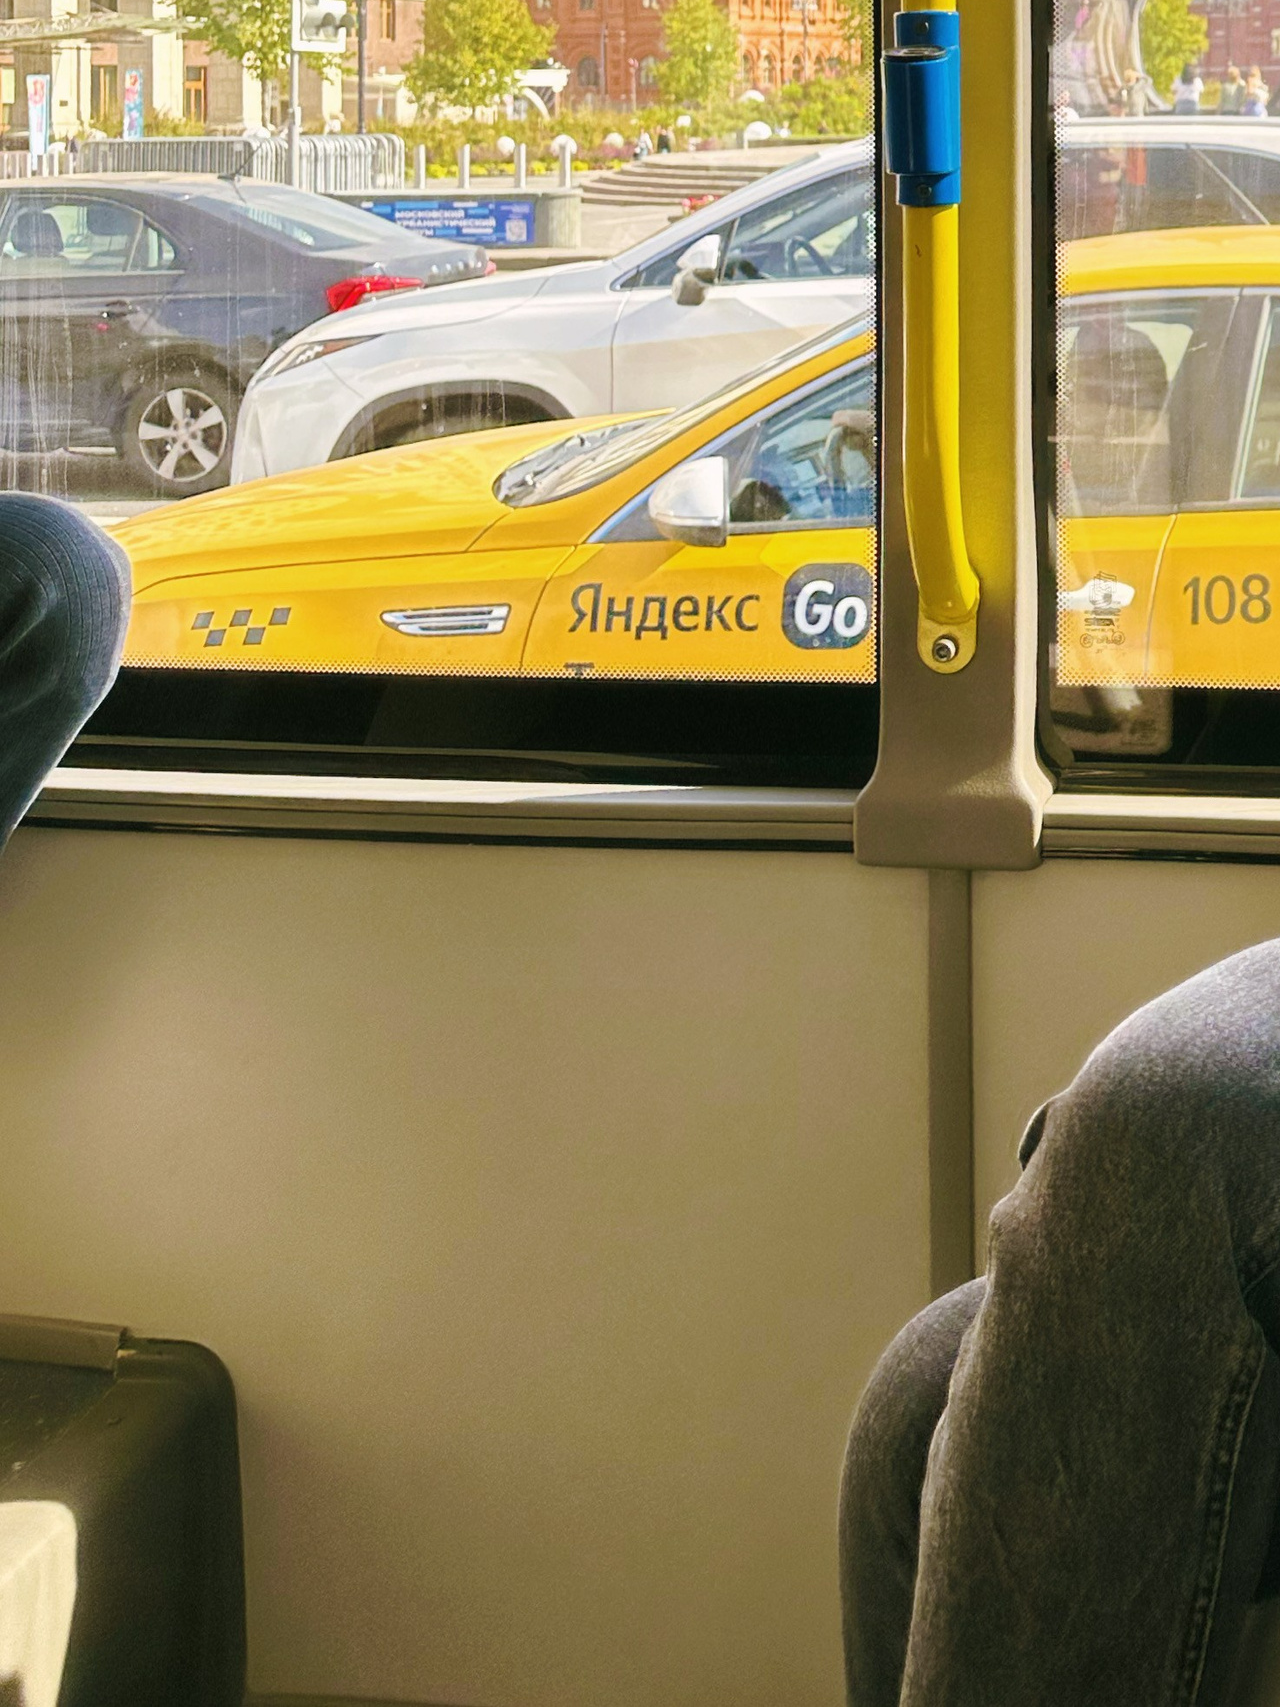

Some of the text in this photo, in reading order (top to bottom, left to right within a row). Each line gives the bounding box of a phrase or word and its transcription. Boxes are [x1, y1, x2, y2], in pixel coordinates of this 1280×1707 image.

[568, 579, 869, 640] Яндекс Go
[1183, 573, 1272, 626] 108
